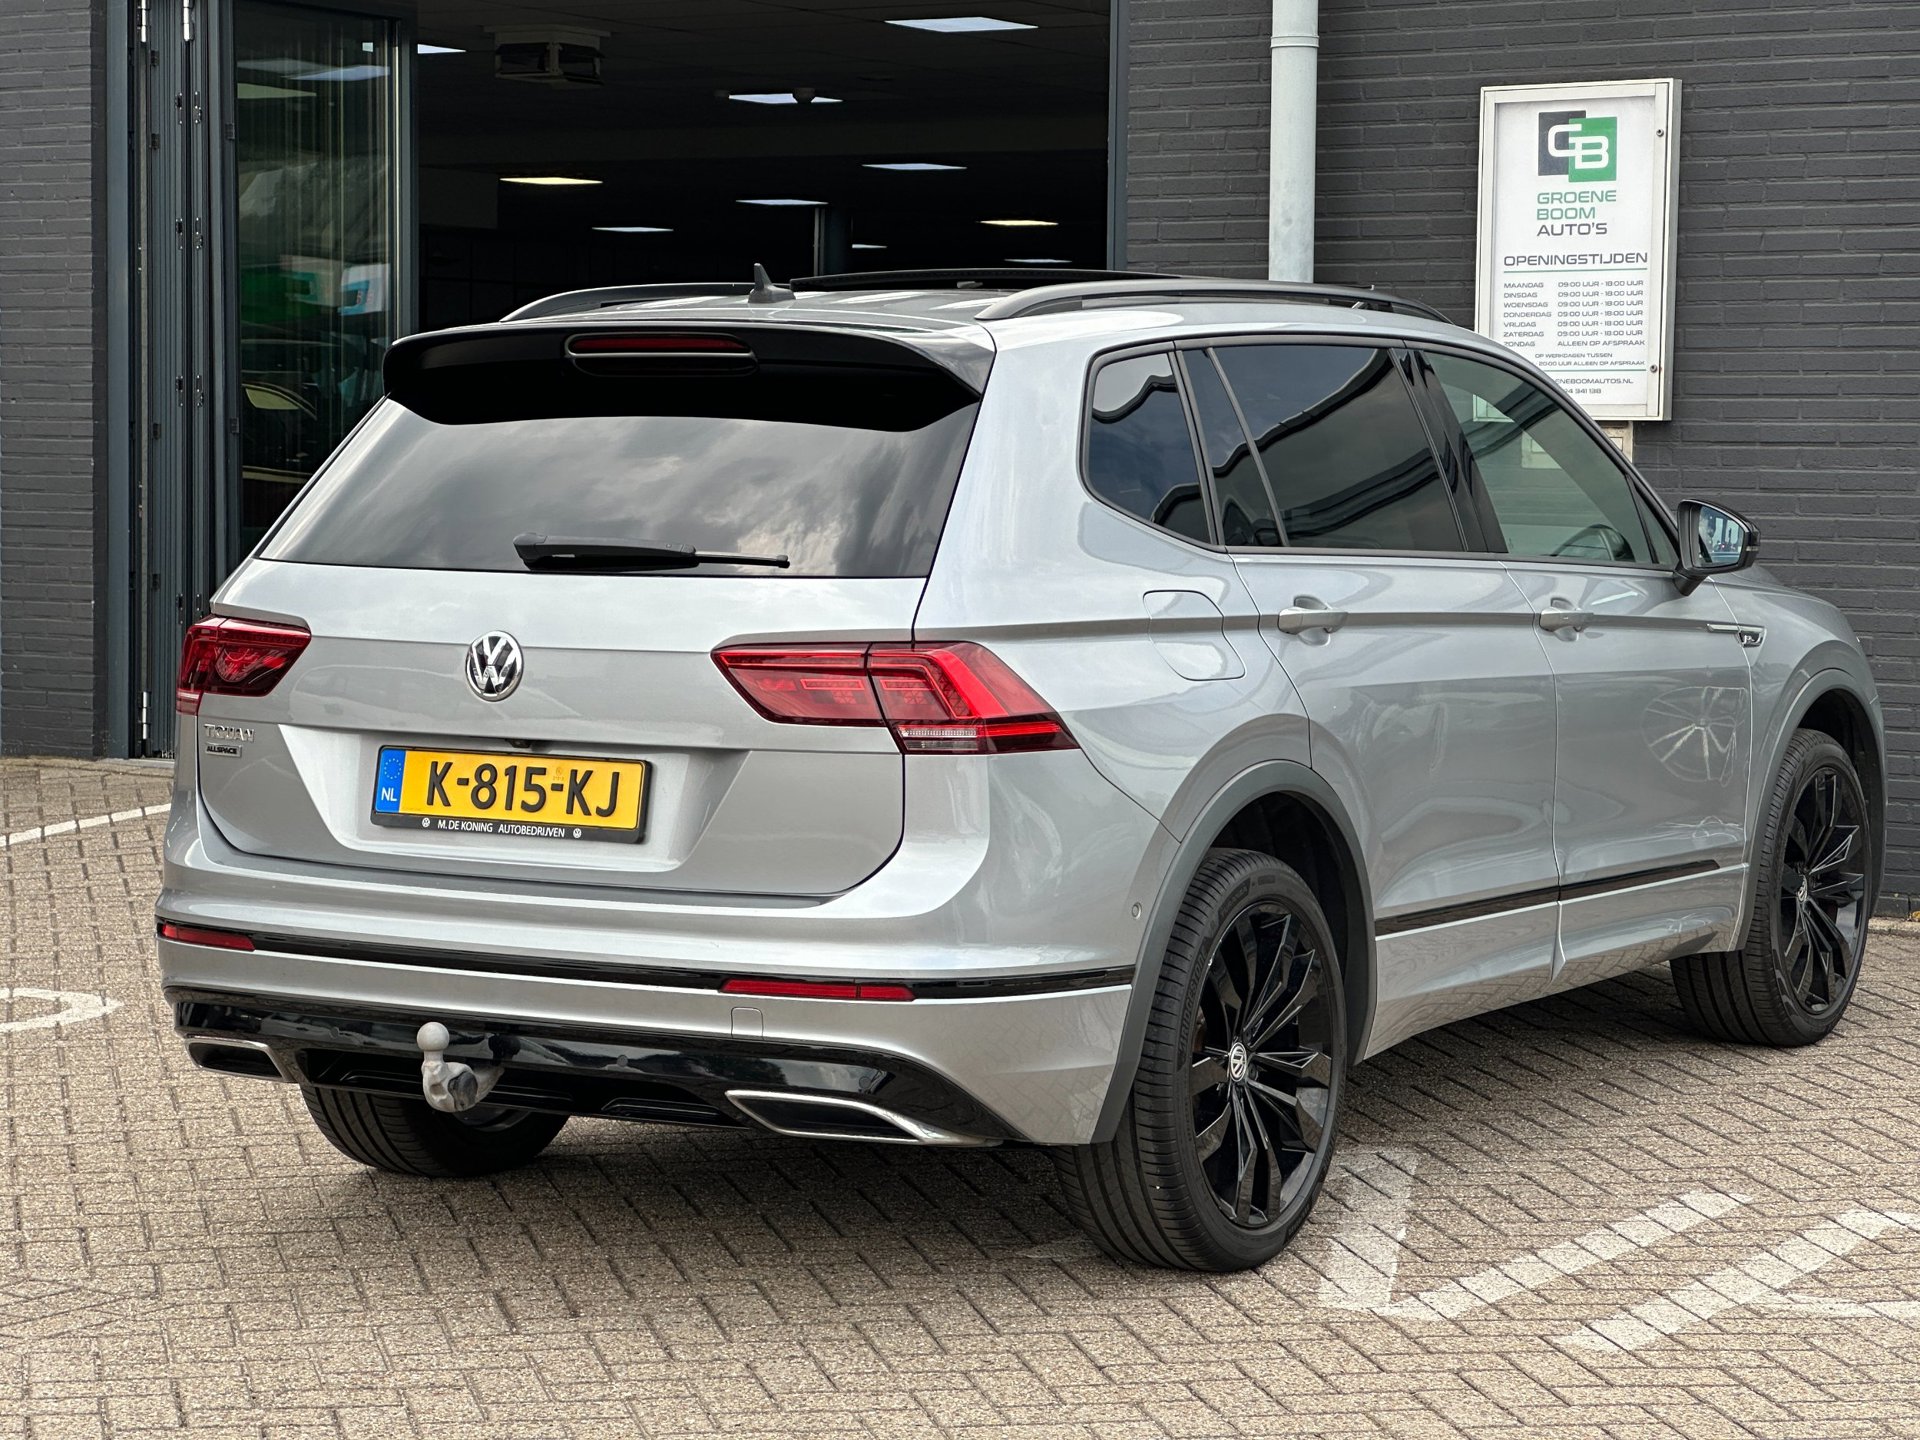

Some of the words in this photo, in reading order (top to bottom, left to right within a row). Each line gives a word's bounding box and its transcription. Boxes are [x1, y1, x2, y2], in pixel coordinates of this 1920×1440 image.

[1537, 190, 1617, 205] GROENE
[1536, 207, 1596, 220] BOOM
[1536, 222, 1608, 236] AUTO'S
[1503, 252, 1648, 267] OPENINGSTIJDEN
[206, 745, 237, 755] ALLSPACE
[381, 786, 398, 802] NL
[426, 760, 620, 818] K-815-KJ
[460, 821, 493, 833] KONING
[498, 823, 565, 838] AUTOBEDRIJVEN
